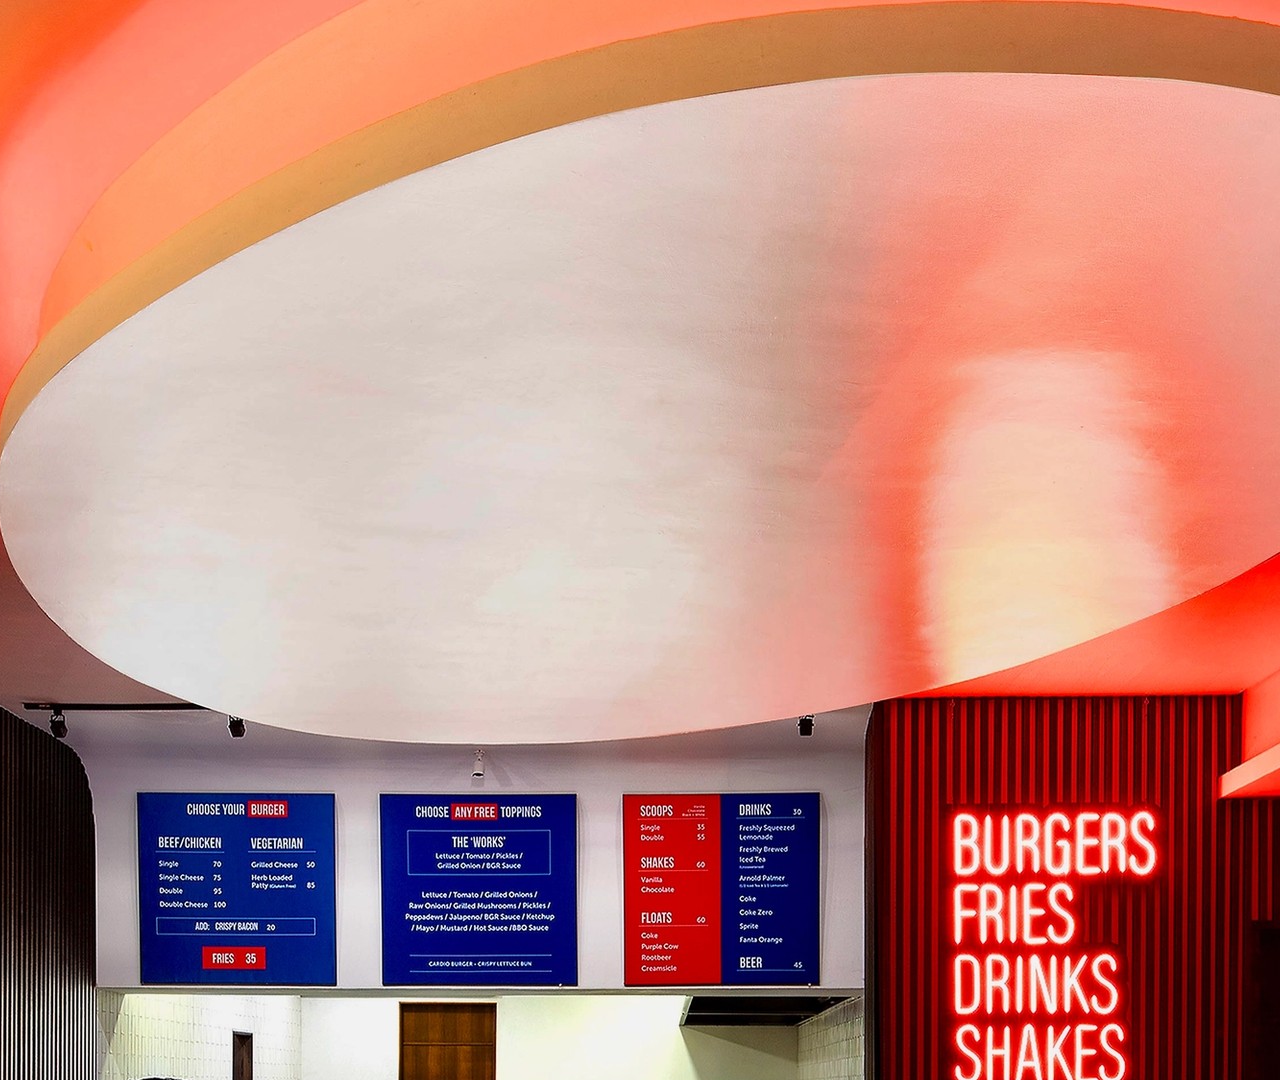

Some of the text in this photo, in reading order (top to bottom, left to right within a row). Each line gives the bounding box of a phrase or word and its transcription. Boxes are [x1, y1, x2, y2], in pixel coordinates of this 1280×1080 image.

[187, 803, 285, 815] CHOOSE YOUR BURGER
[415, 806, 542, 818] CHOOSE ANY FREE TOPPINGS
[640, 805, 673, 817] SCOOPS
[739, 804, 771, 816] DRINKS
[640, 824, 660, 832] Single
[763, 824, 795, 832] Squeezed
[158, 836, 222, 848] BEEF/CHICKEN
[251, 837, 303, 849] VEGETARIAN
[452, 836, 468, 847] THE
[953, 811, 1156, 876] BURGERS
[739, 846, 763, 854] Freshly
[158, 860, 222, 868] Single 70
[640, 857, 674, 869] SHAKES
[159, 874, 179, 882] Single
[251, 882, 269, 890] Patty
[641, 912, 672, 924] FLOATS
[953, 882, 1075, 945] FRIES
[195, 922, 210, 931] ADD:
[215, 922, 237, 931] CRISPY
[237, 922, 258, 931] BACON
[739, 922, 759, 930] Sprite
[641, 943, 663, 951] Purple
[212, 953, 256, 963] FRIES 35
[740, 957, 762, 968] BEER
[953, 953, 1119, 1015] DRINKS
